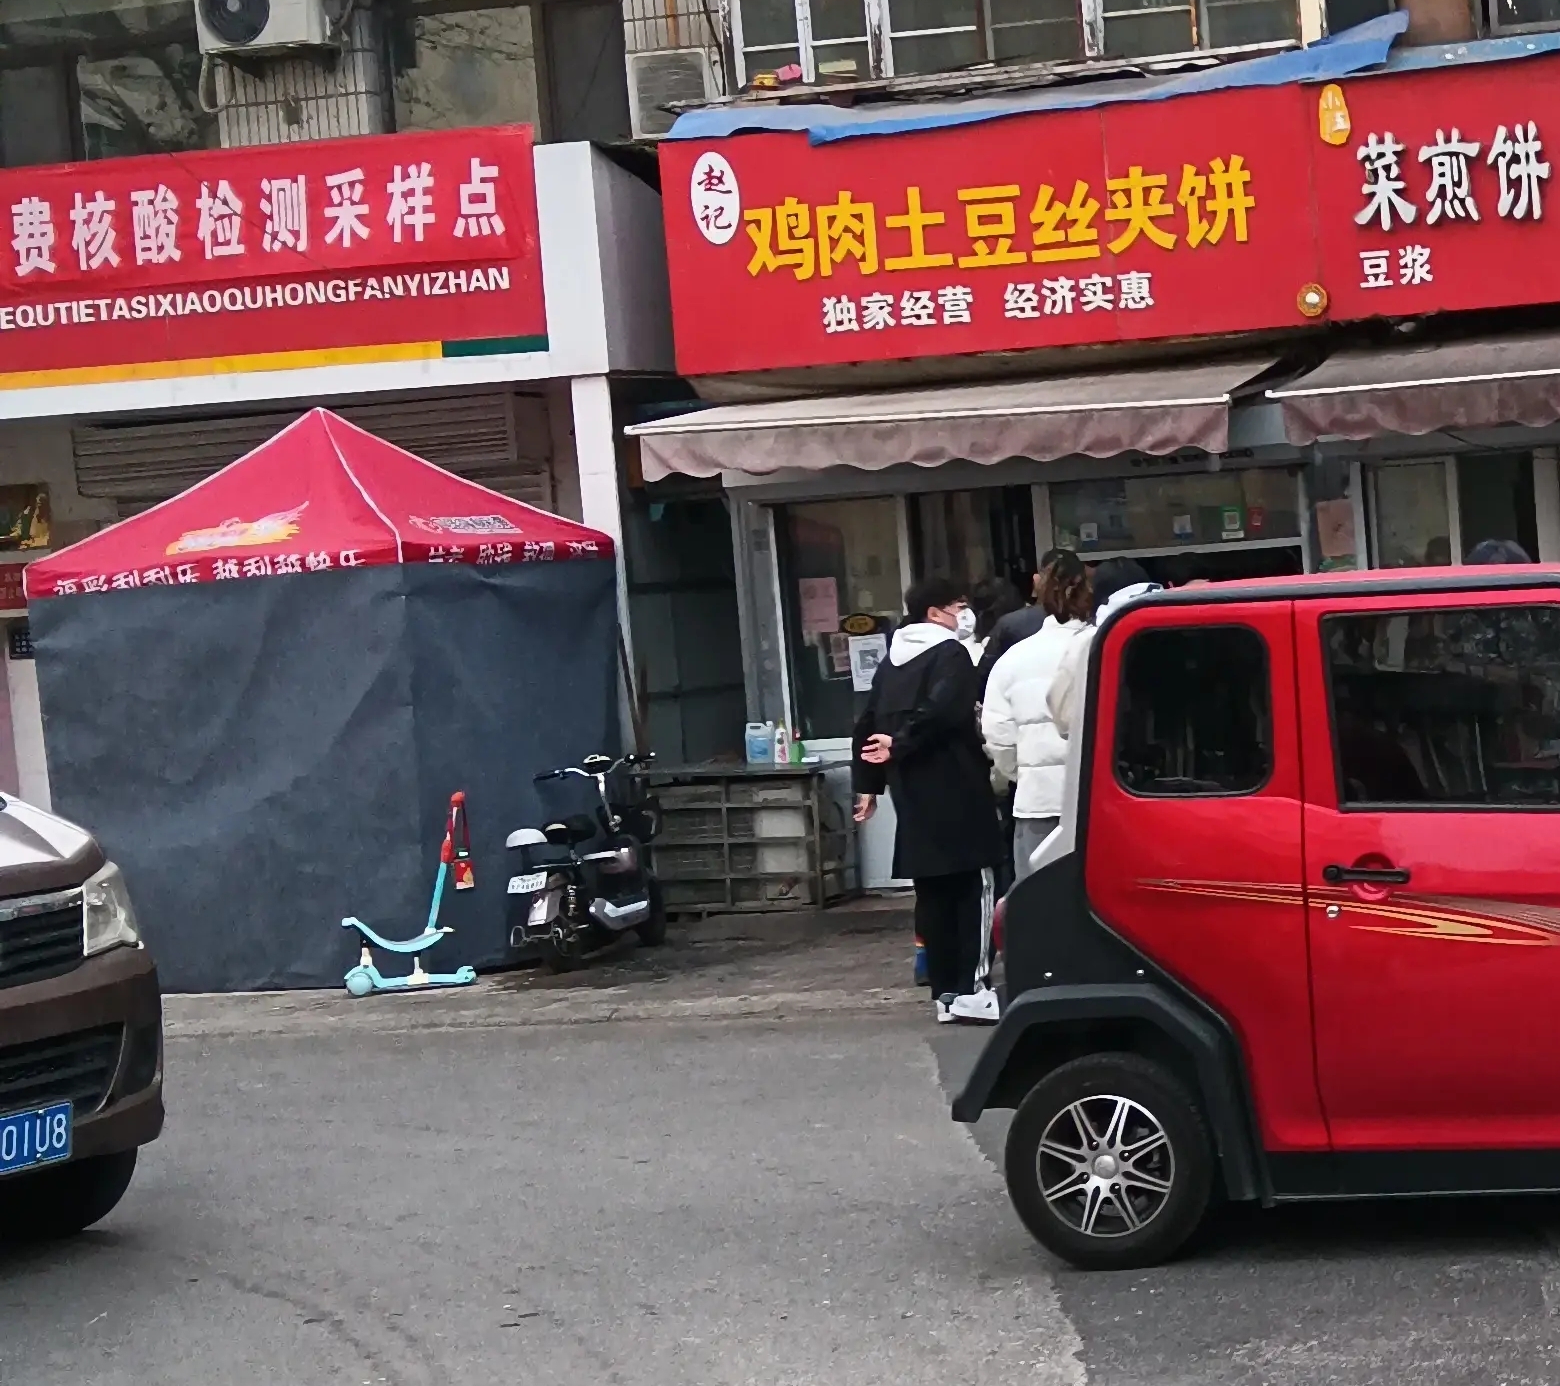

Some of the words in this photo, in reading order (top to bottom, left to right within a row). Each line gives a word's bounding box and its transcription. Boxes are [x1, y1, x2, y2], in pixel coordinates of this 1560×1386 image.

[10, 156, 504, 277] 费核酸检测采样点
[697, 162, 734, 232] 赵记
[744, 154, 1257, 281] 鸡肉土豆丝夹饼
[1355, 119, 1552, 231] 菜煎饼
[821, 285, 974, 334] 独家经营
[1003, 270, 1156, 320] 经济实惠
[1358, 243, 1435, 289] 豆浆
